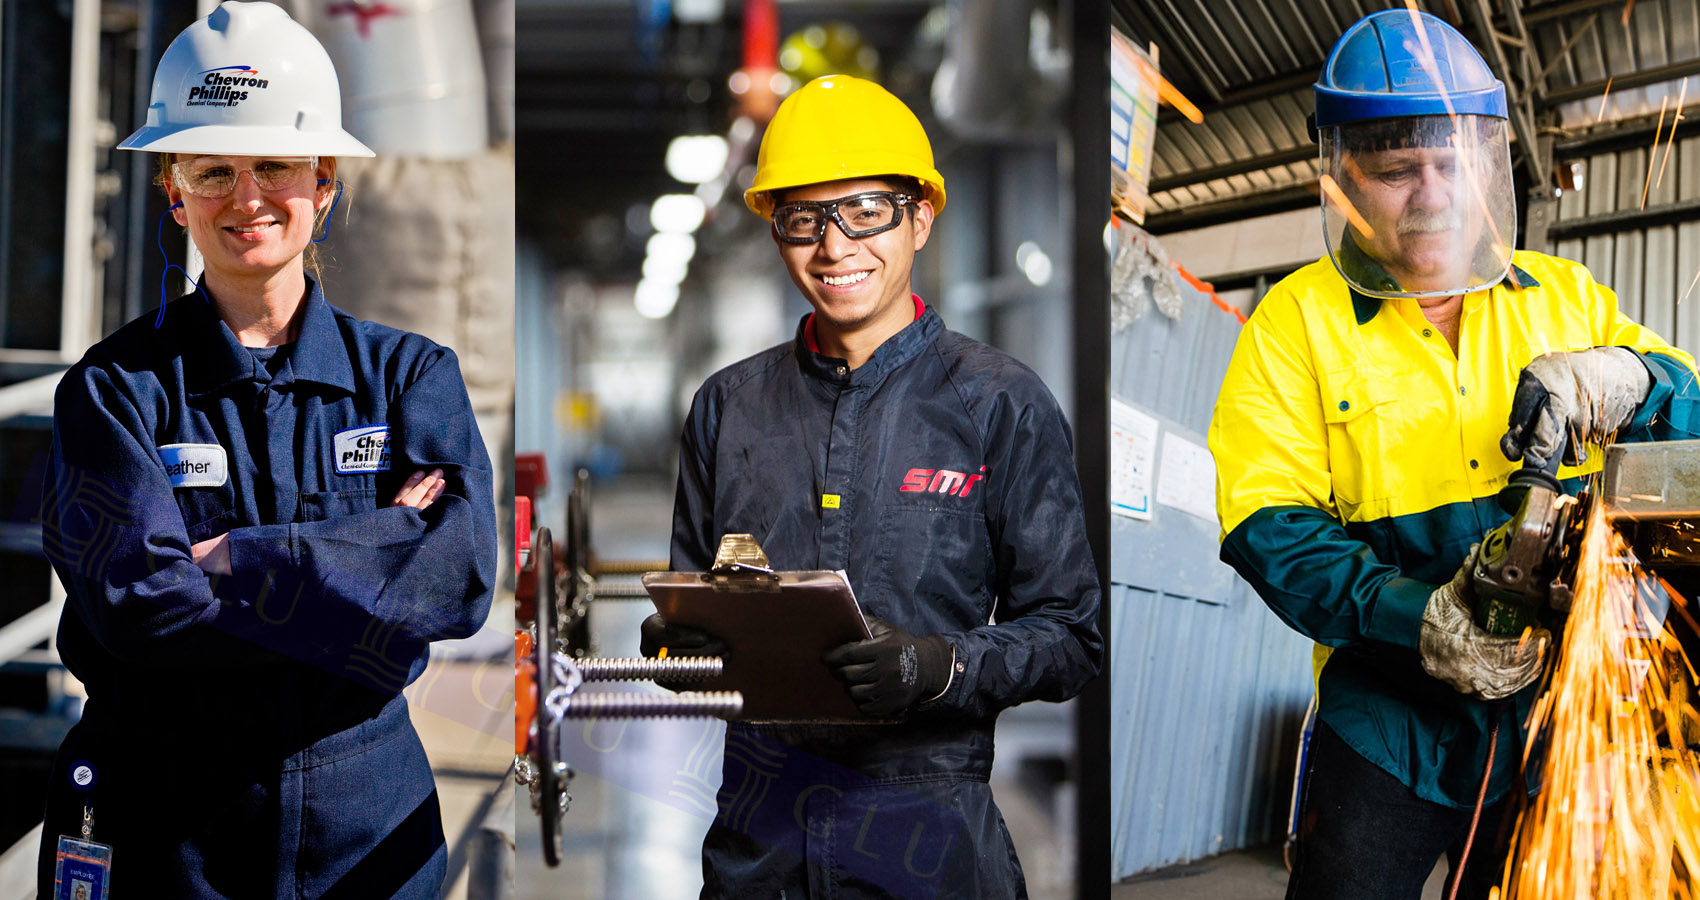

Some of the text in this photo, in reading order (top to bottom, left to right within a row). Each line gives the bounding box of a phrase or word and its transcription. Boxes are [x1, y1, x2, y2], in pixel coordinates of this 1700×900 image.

[204, 73, 269, 88] Chevron
[188, 86, 248, 106] Phillips
[206, 100, 227, 108] Company
[356, 436, 392, 448] Chev
[342, 449, 392, 468] Phillip
[164, 459, 210, 477] eather
